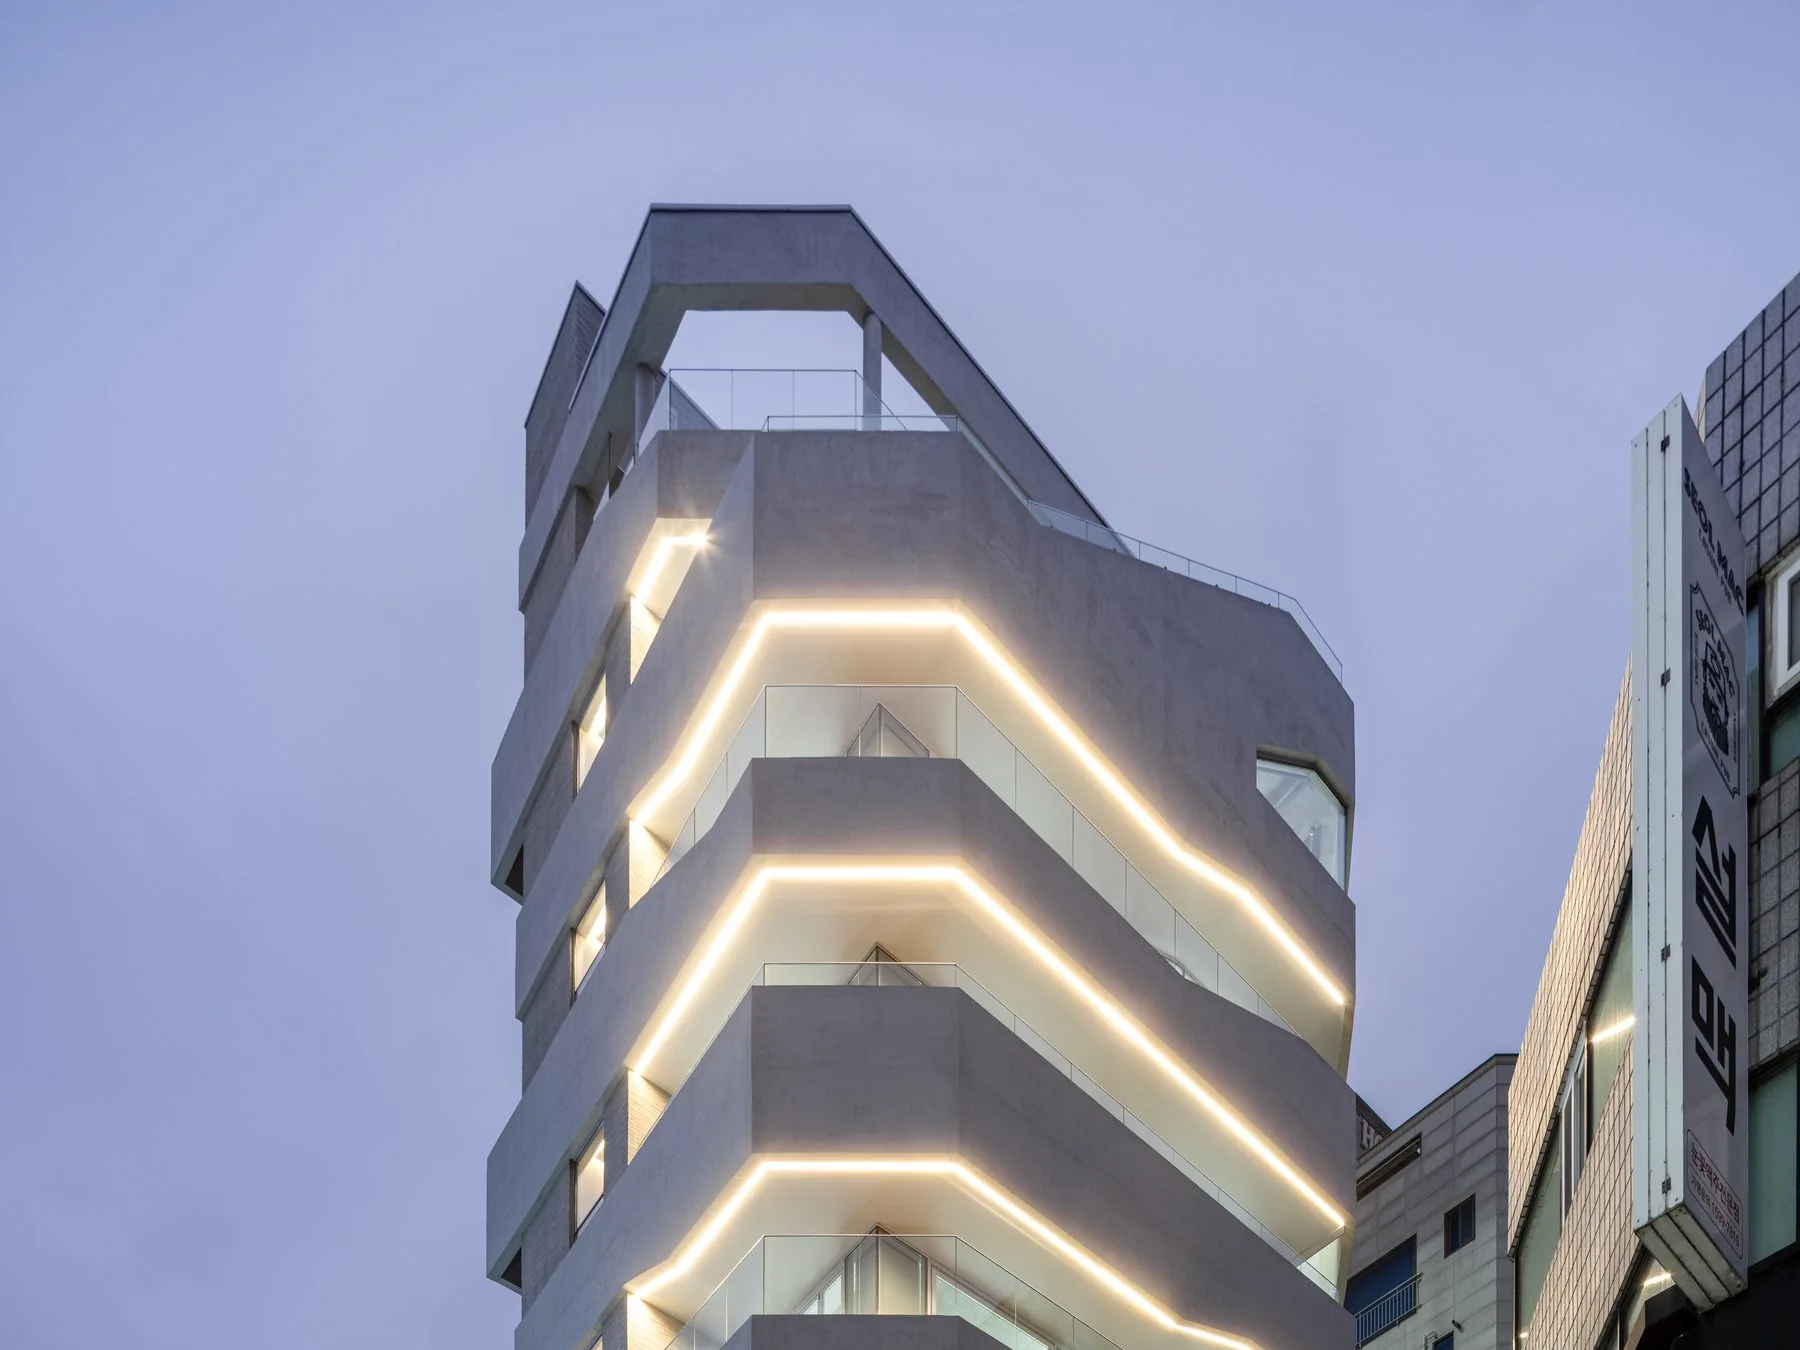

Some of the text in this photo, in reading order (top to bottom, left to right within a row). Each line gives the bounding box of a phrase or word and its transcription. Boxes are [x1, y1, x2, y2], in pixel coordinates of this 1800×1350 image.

[1684, 466, 1744, 617] SEOL MAC
[1692, 795, 1736, 1137] 설맥
